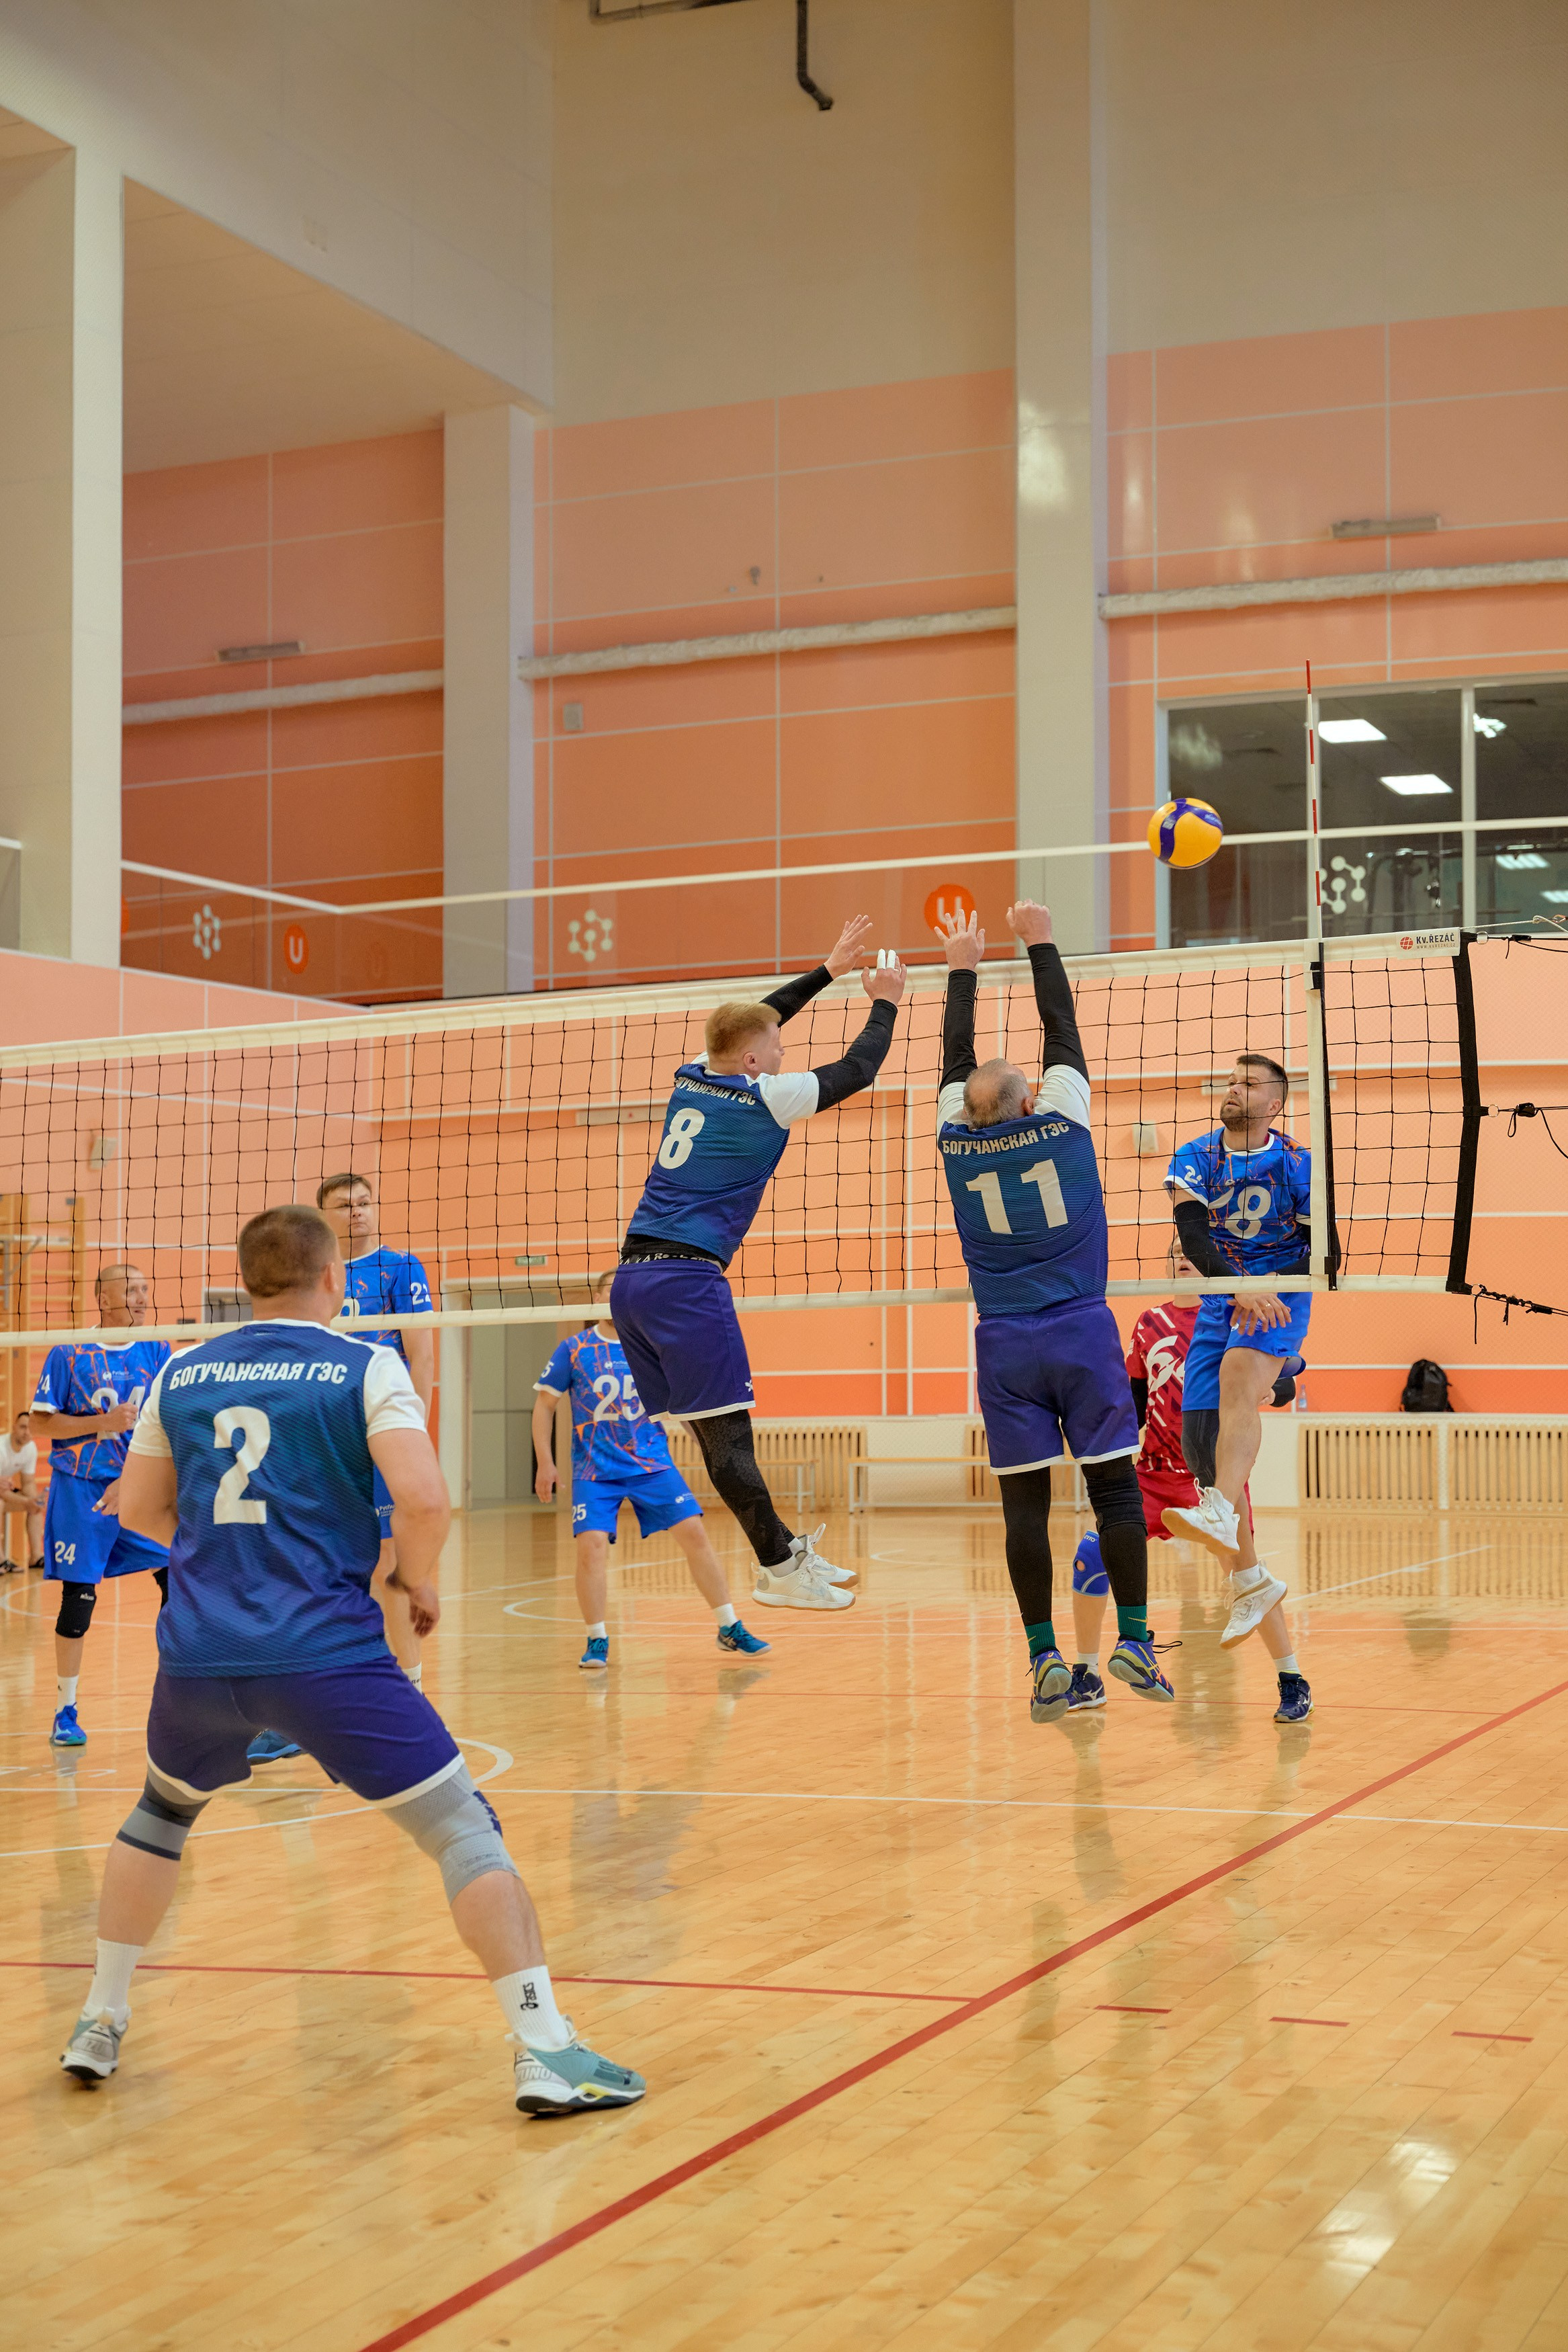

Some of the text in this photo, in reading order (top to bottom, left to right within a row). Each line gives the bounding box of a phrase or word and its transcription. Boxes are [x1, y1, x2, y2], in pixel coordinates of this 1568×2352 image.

[731, 1090, 756, 1105] ГЭС
[658, 1107, 705, 1169] 8
[942, 1122, 1070, 1155] БОГУЧАНСКАЯ ГЭС
[965, 1159, 1069, 1234] 11
[169, 1362, 348, 1390] БОГУЧАНСКАЯ ГЭС
[593, 1374, 646, 1422] 25
[213, 1406, 271, 1525] 2
[54, 1540, 77, 1565] 24
